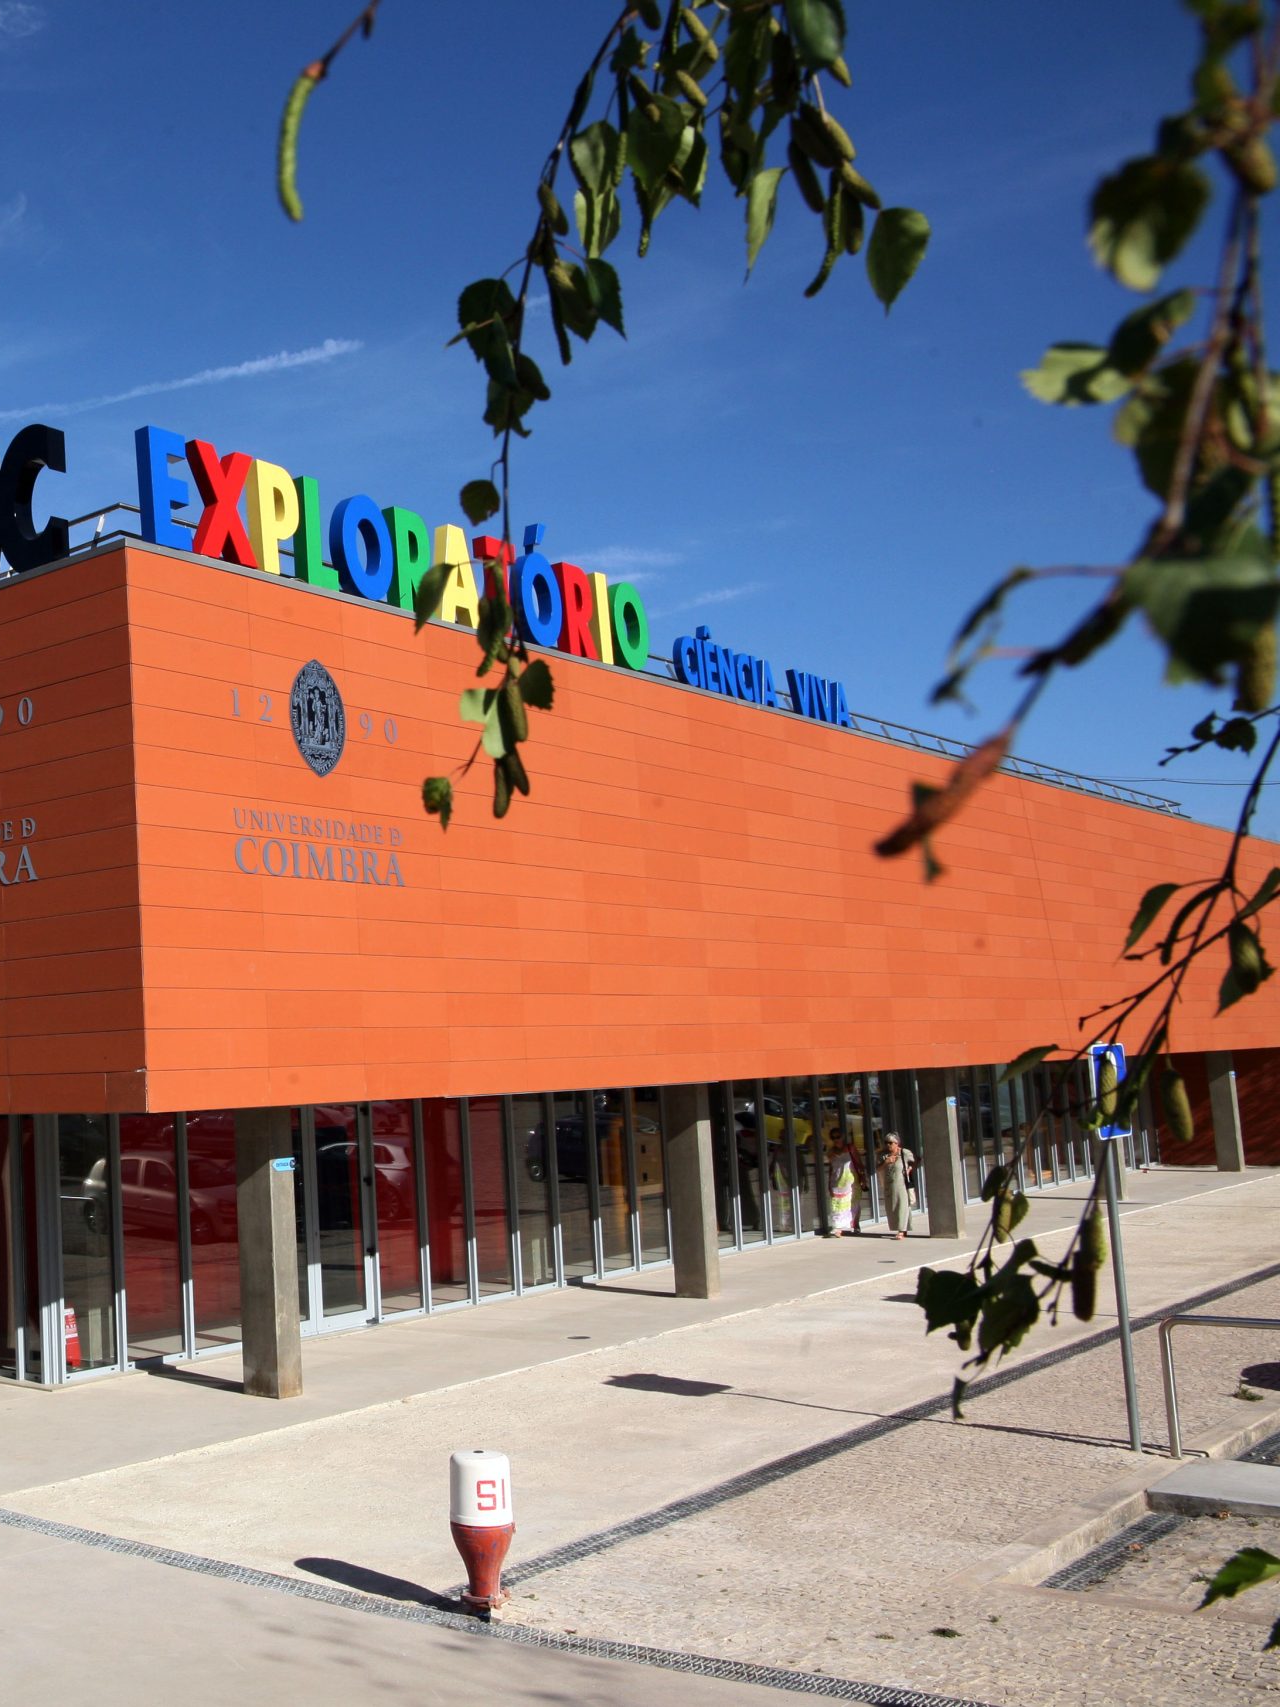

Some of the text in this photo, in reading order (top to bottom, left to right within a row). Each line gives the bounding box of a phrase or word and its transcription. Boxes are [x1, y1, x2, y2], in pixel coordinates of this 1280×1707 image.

[134, 425, 650, 670] EXPLORATÓRIO
[785, 669, 852, 727] VIVA
[233, 807, 385, 844] UNIVERSIDADE
[234, 836, 405, 887] COIMBRA
